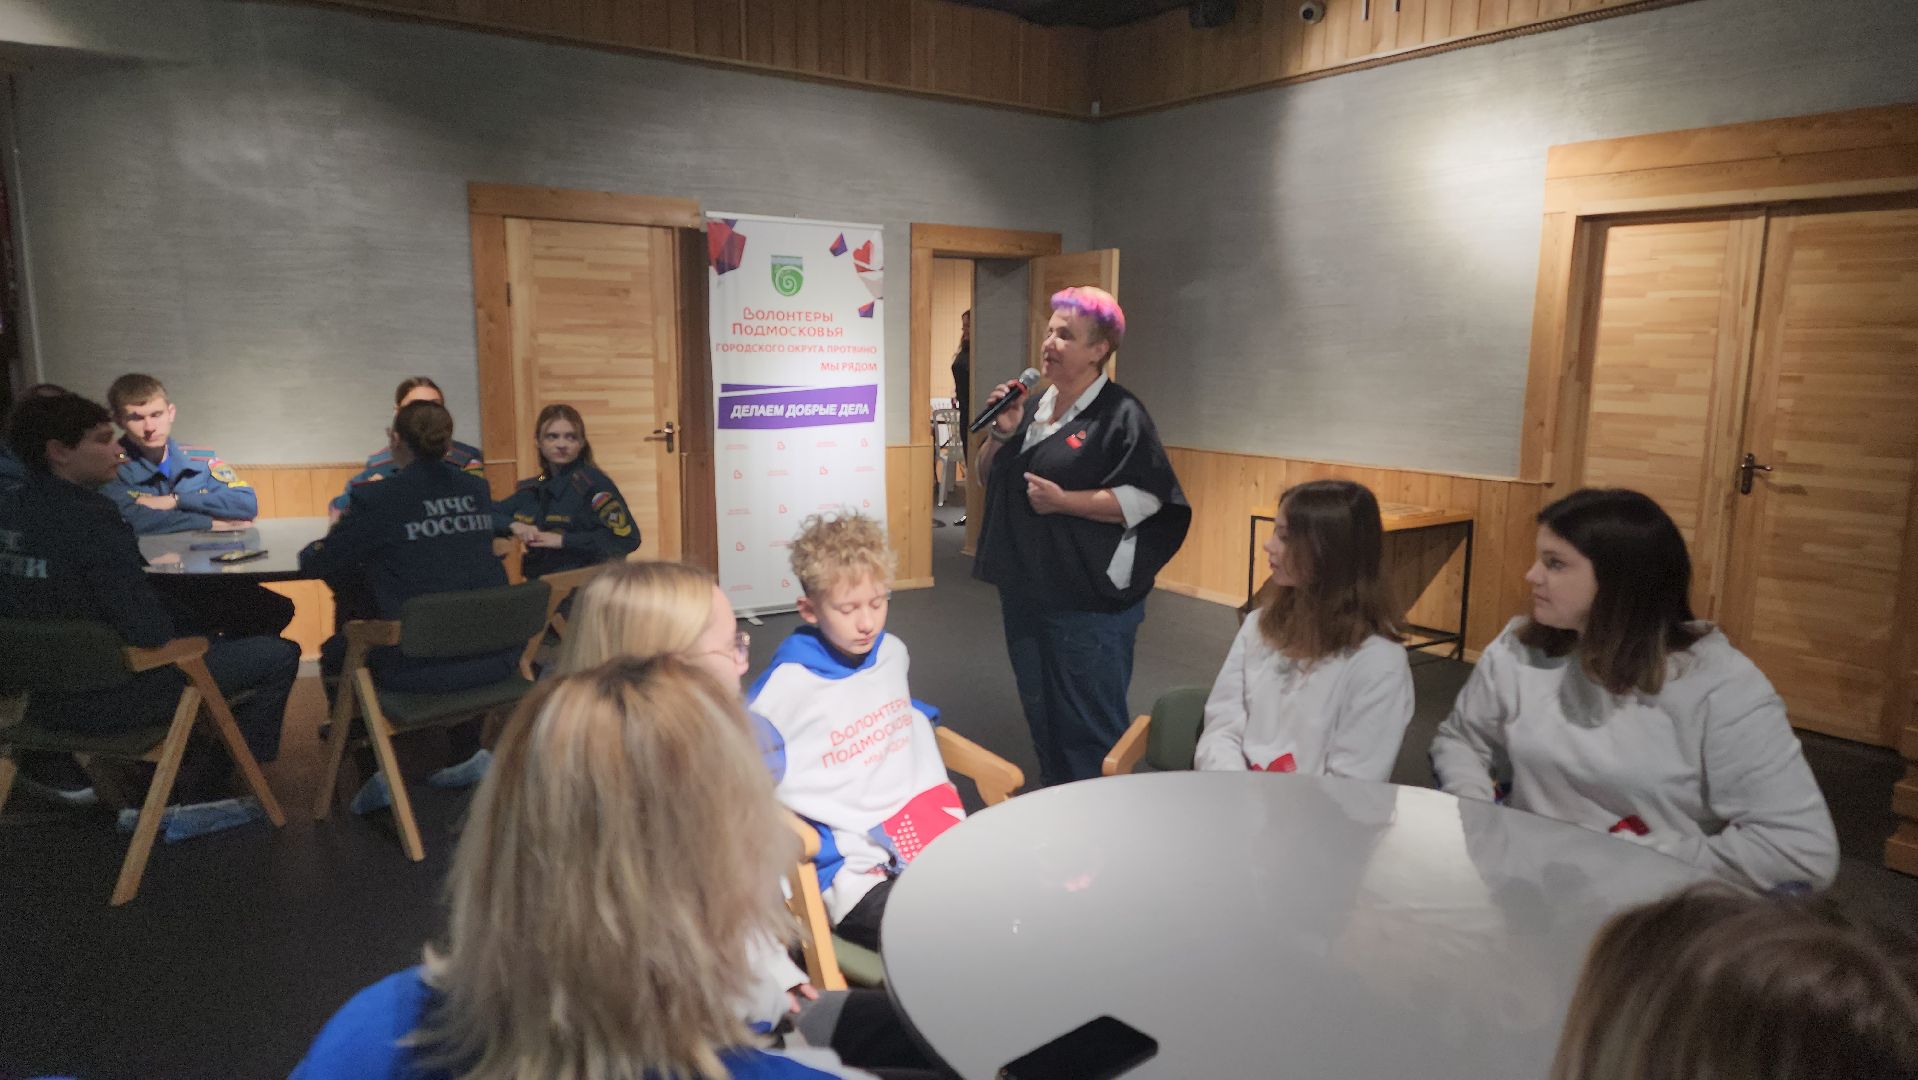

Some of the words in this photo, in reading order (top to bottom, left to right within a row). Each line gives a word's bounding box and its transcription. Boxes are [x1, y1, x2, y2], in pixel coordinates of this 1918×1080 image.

[716, 343, 785, 354] ГОРОДСКОГО
[787, 344, 825, 354] ОКРУГА
[827, 345, 877, 354] ПРОТВИНО
[821, 362, 839, 372] МЫ
[841, 362, 878, 373] РЯДОМ
[730, 404, 785, 419] ДЕЛАЕМ
[785, 403, 837, 419] ДОБРЫЕ
[838, 402, 870, 417] ДЕЛА
[422, 495, 478, 517] МЧС
